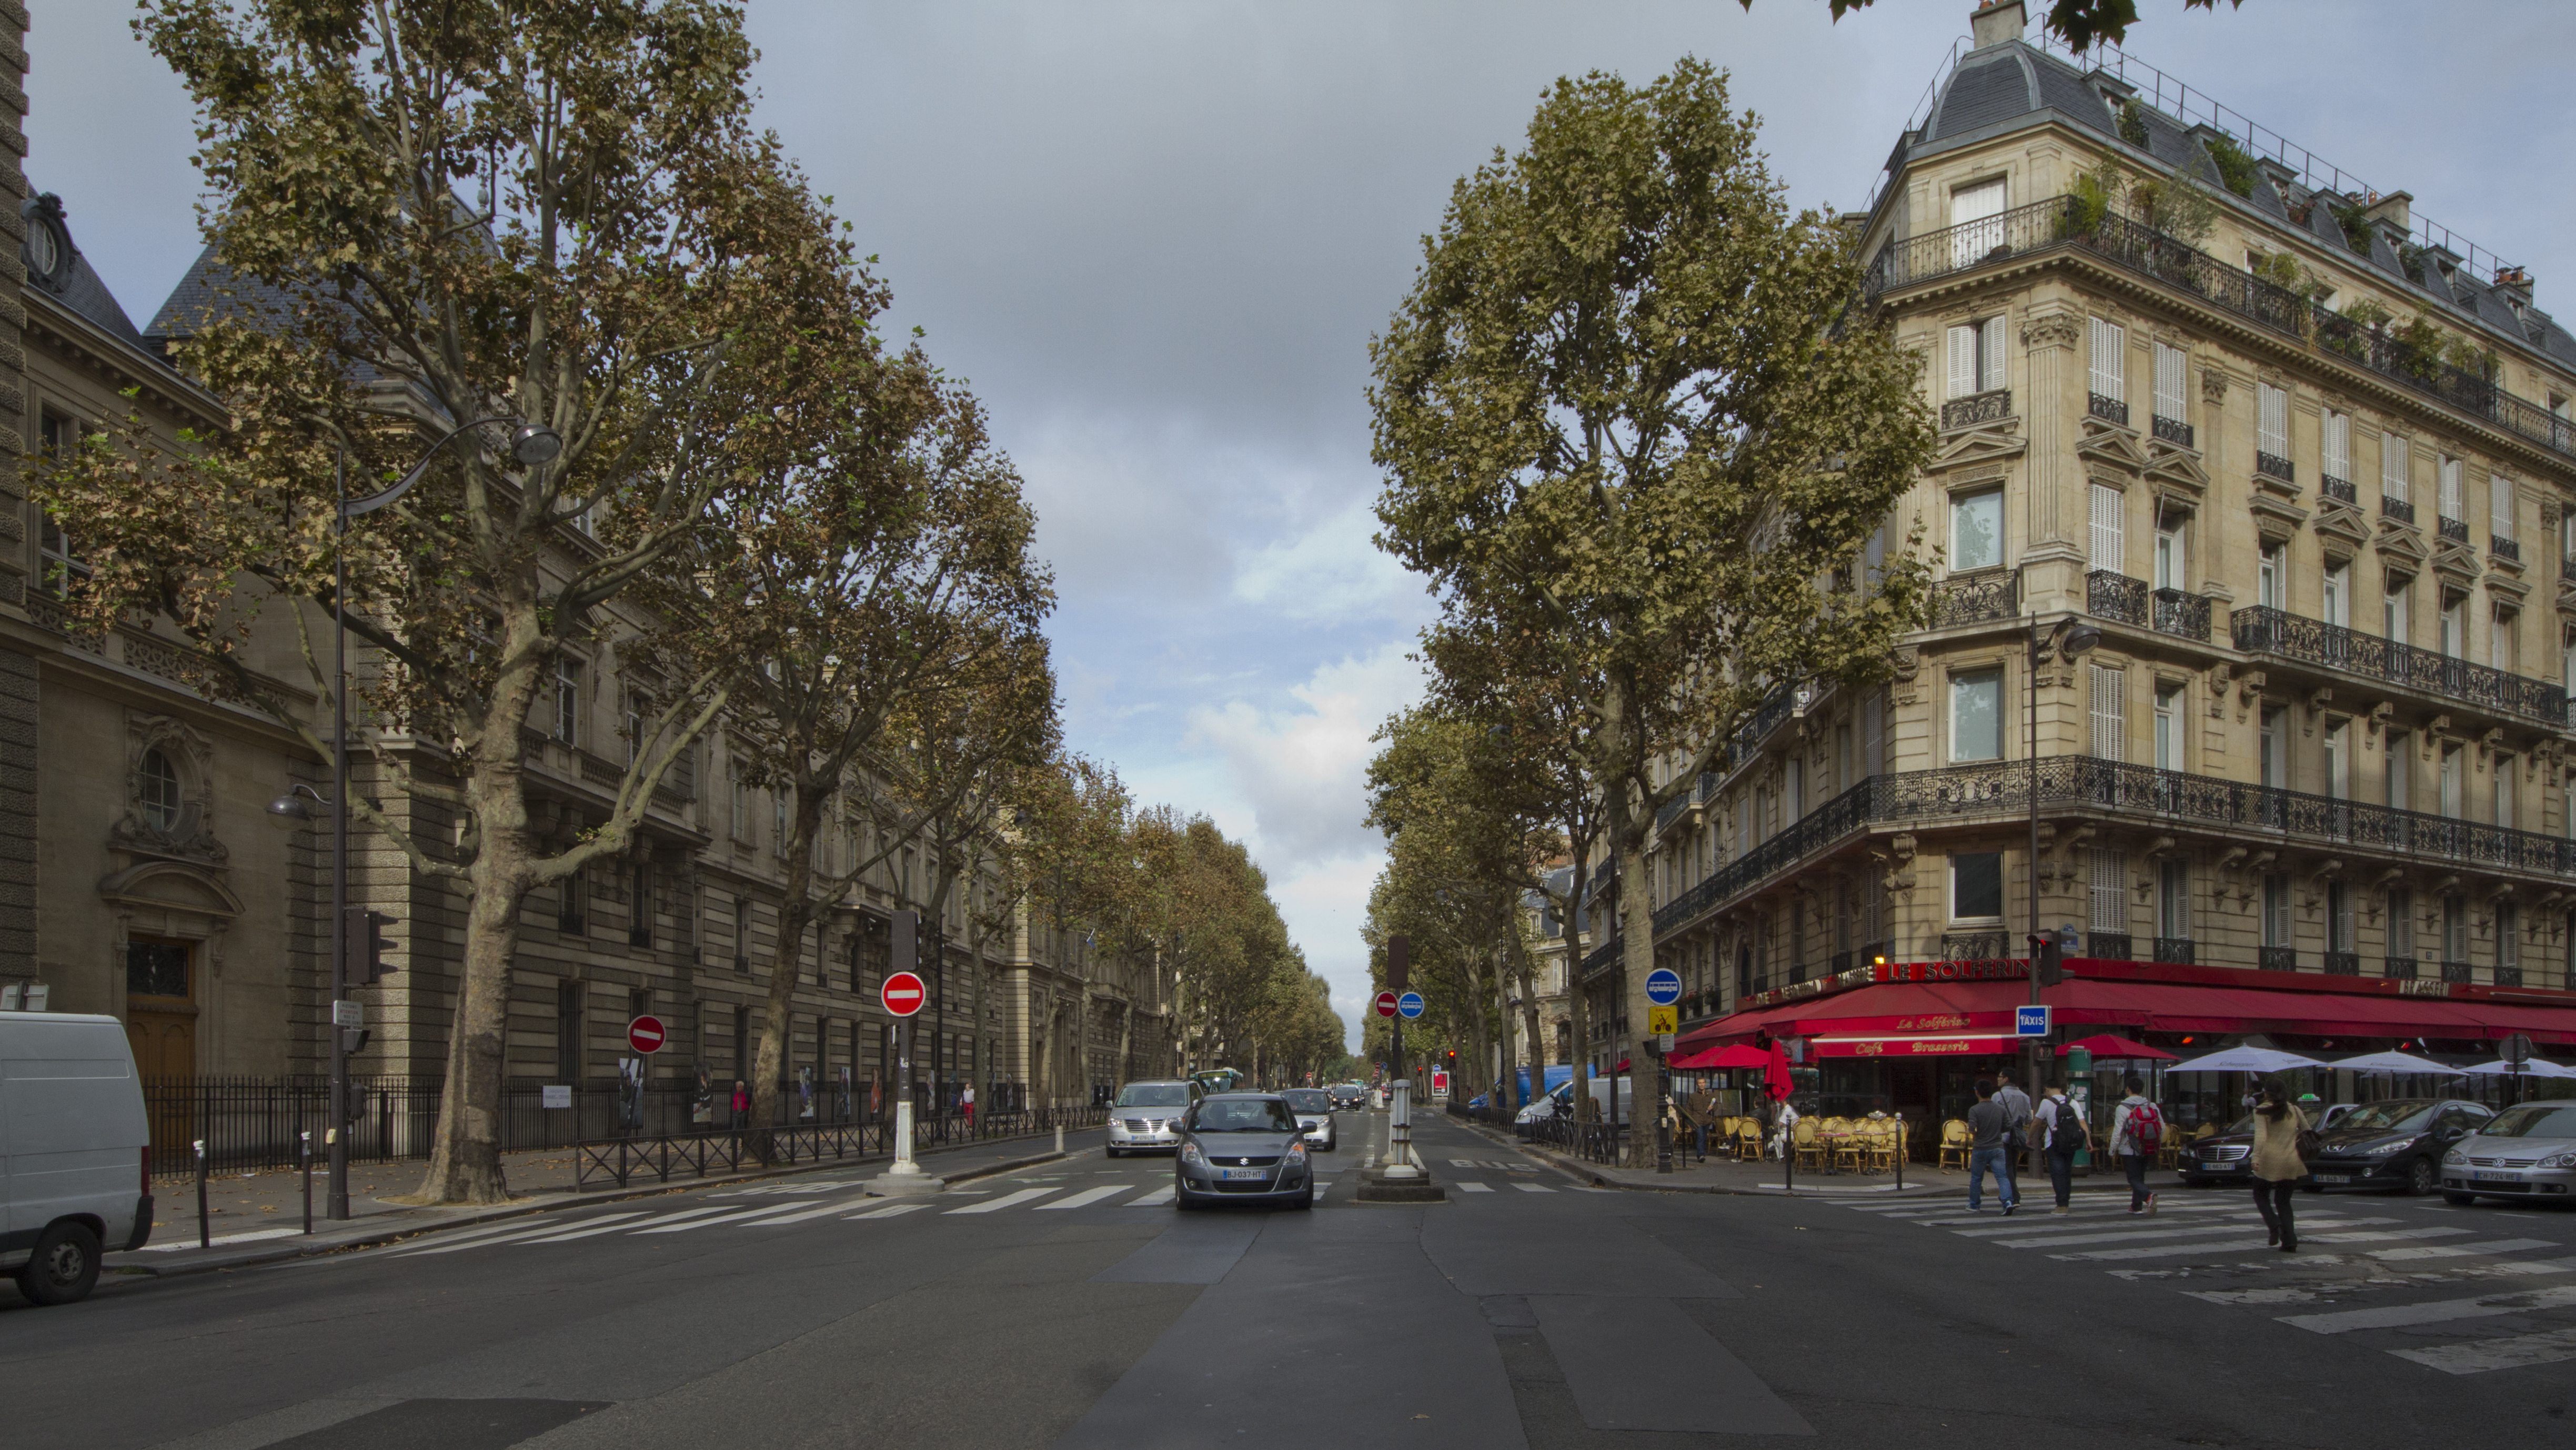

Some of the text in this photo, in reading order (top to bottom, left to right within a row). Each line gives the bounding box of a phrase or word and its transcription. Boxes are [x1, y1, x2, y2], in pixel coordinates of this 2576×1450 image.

[1889, 960, 2041, 980] LE SOLFERIN
[1897, 1016, 1970, 1030] Le Solférino
[2020, 1015, 2044, 1026] TAXIS
[1856, 1042, 1884, 1055] Café
[1912, 1041, 1970, 1053] Brasserie
[1448, 1159, 1541, 1172] BUS
